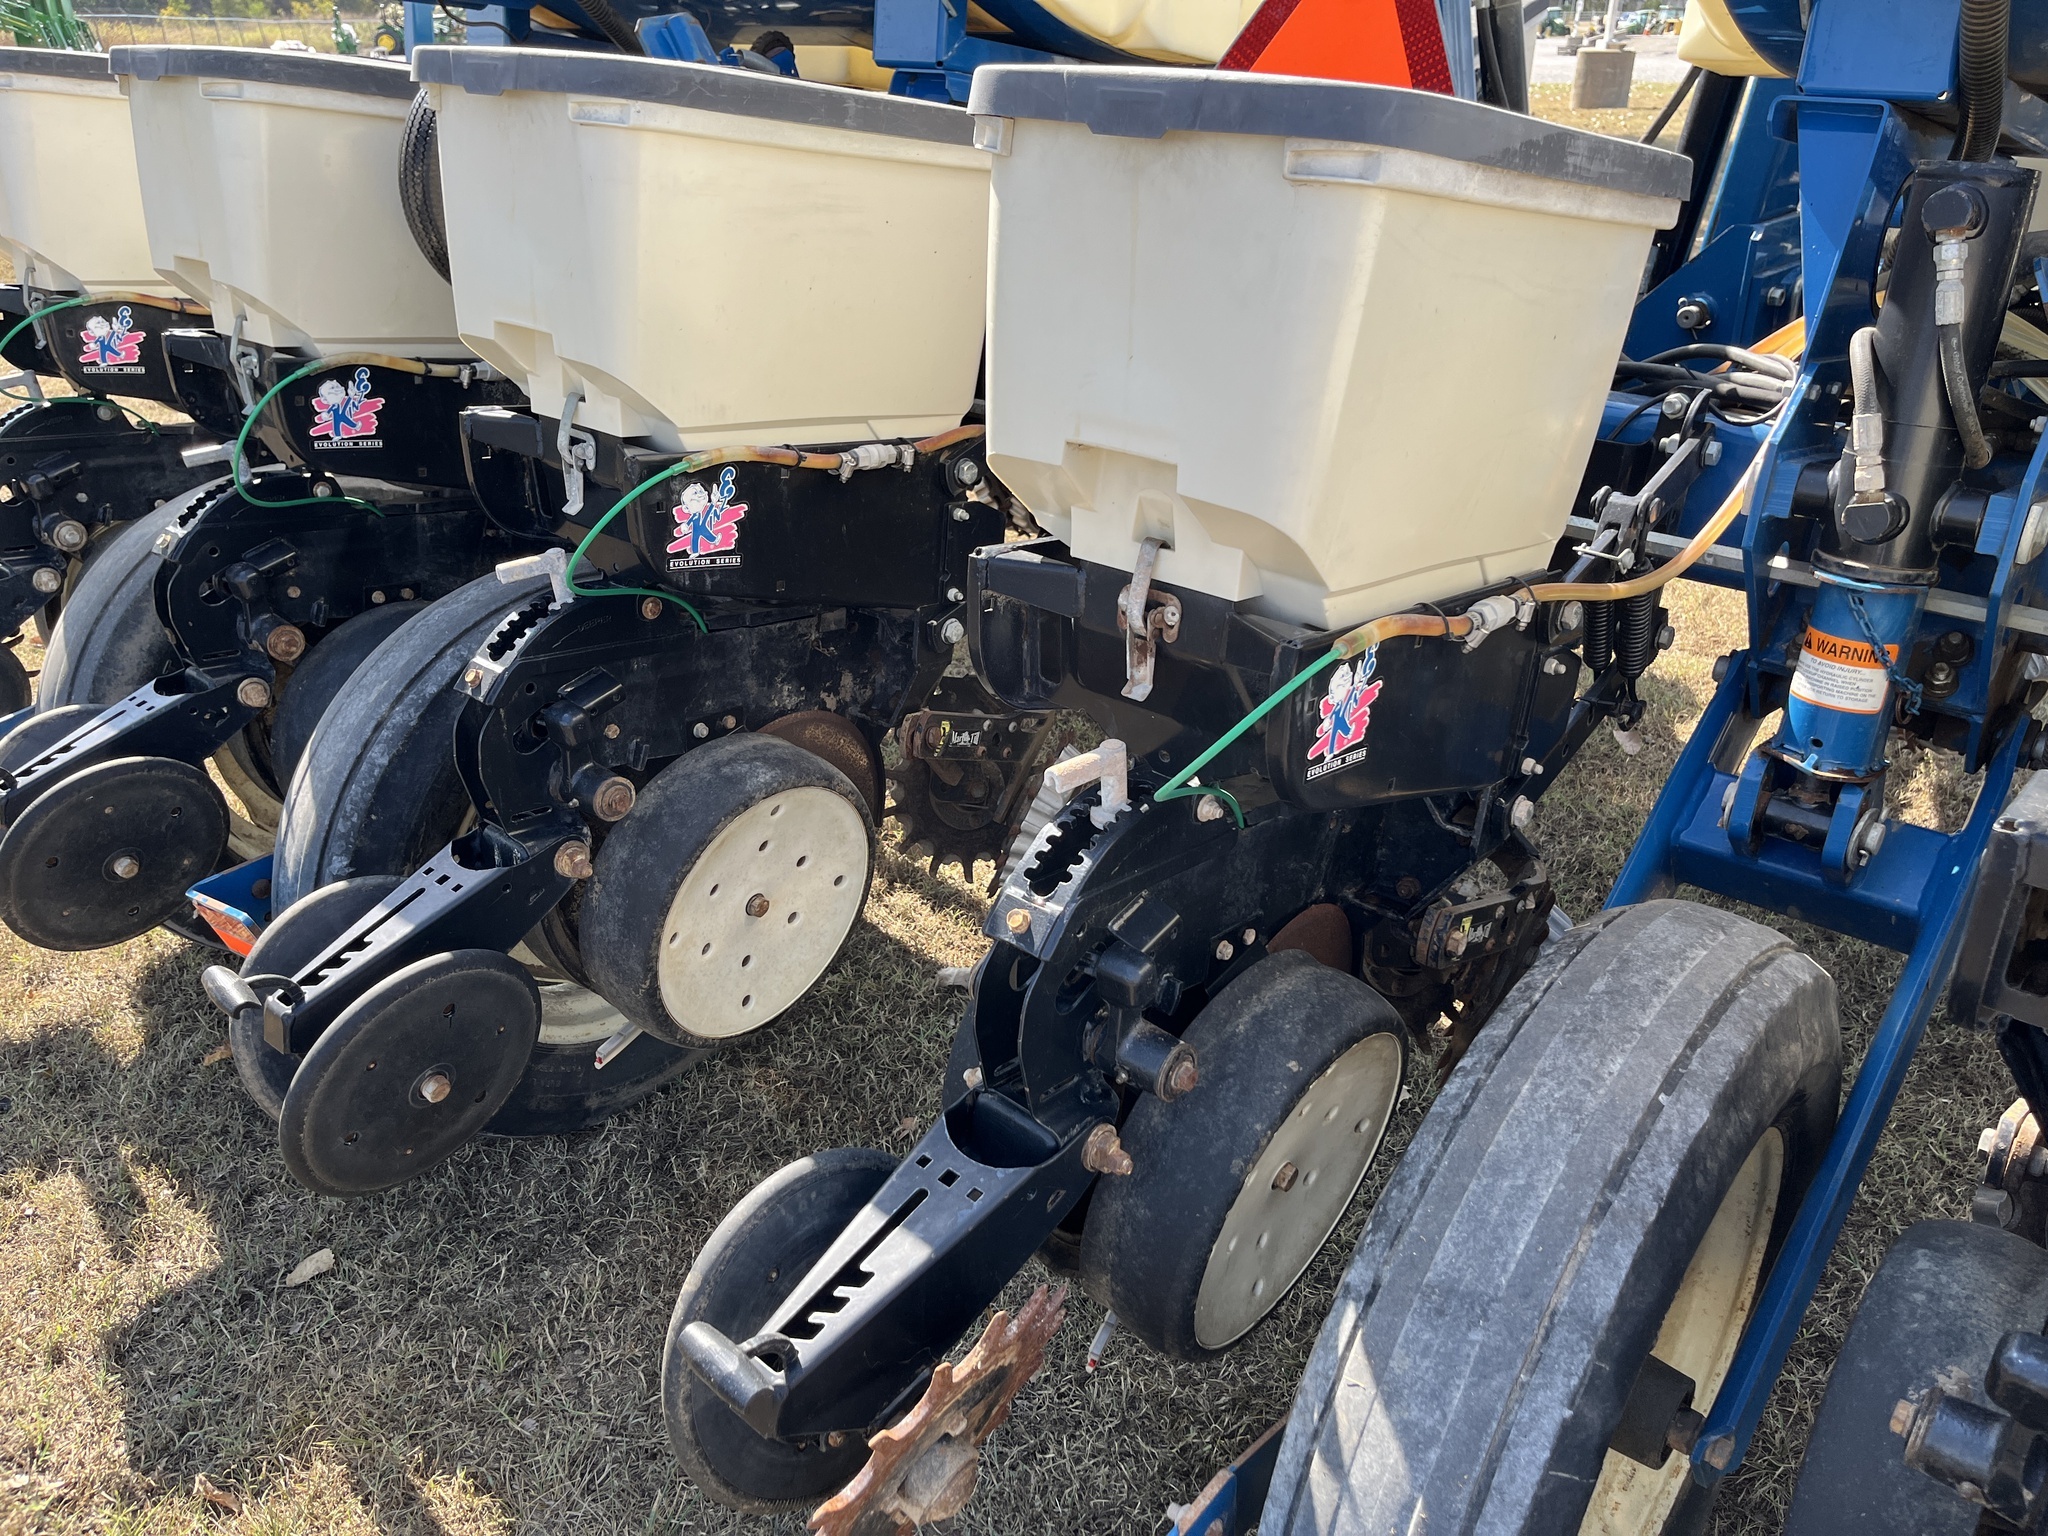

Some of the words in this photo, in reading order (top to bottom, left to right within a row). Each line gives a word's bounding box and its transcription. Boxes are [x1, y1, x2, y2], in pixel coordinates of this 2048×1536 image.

[314, 441, 354, 449] EVOLUTION
[669, 558, 711, 569] EVOLUTION
[715, 556, 741, 565] SERIES
[1816, 637, 1891, 664] WARNIN
[1817, 660, 1836, 670] AVOID
[1306, 758, 1342, 778] EVOLUTION
[1345, 749, 1367, 763] SERIES
